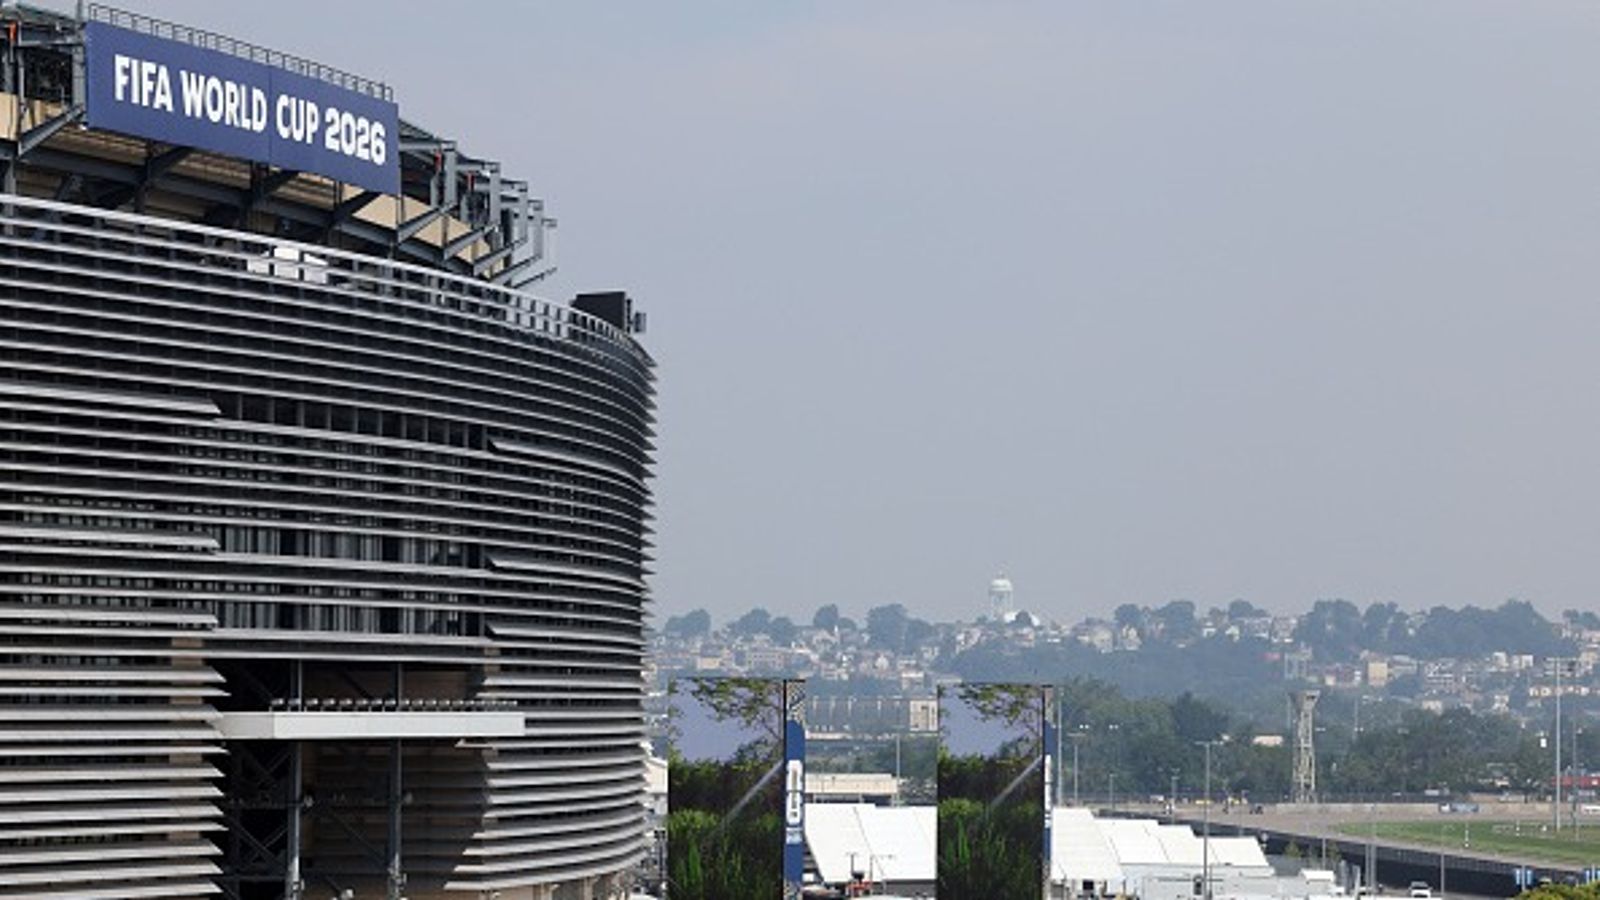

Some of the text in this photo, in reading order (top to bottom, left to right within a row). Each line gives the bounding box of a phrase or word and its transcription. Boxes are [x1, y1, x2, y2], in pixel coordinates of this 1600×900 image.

[114, 54, 386, 165] FIFA WORLD CUP 2026
